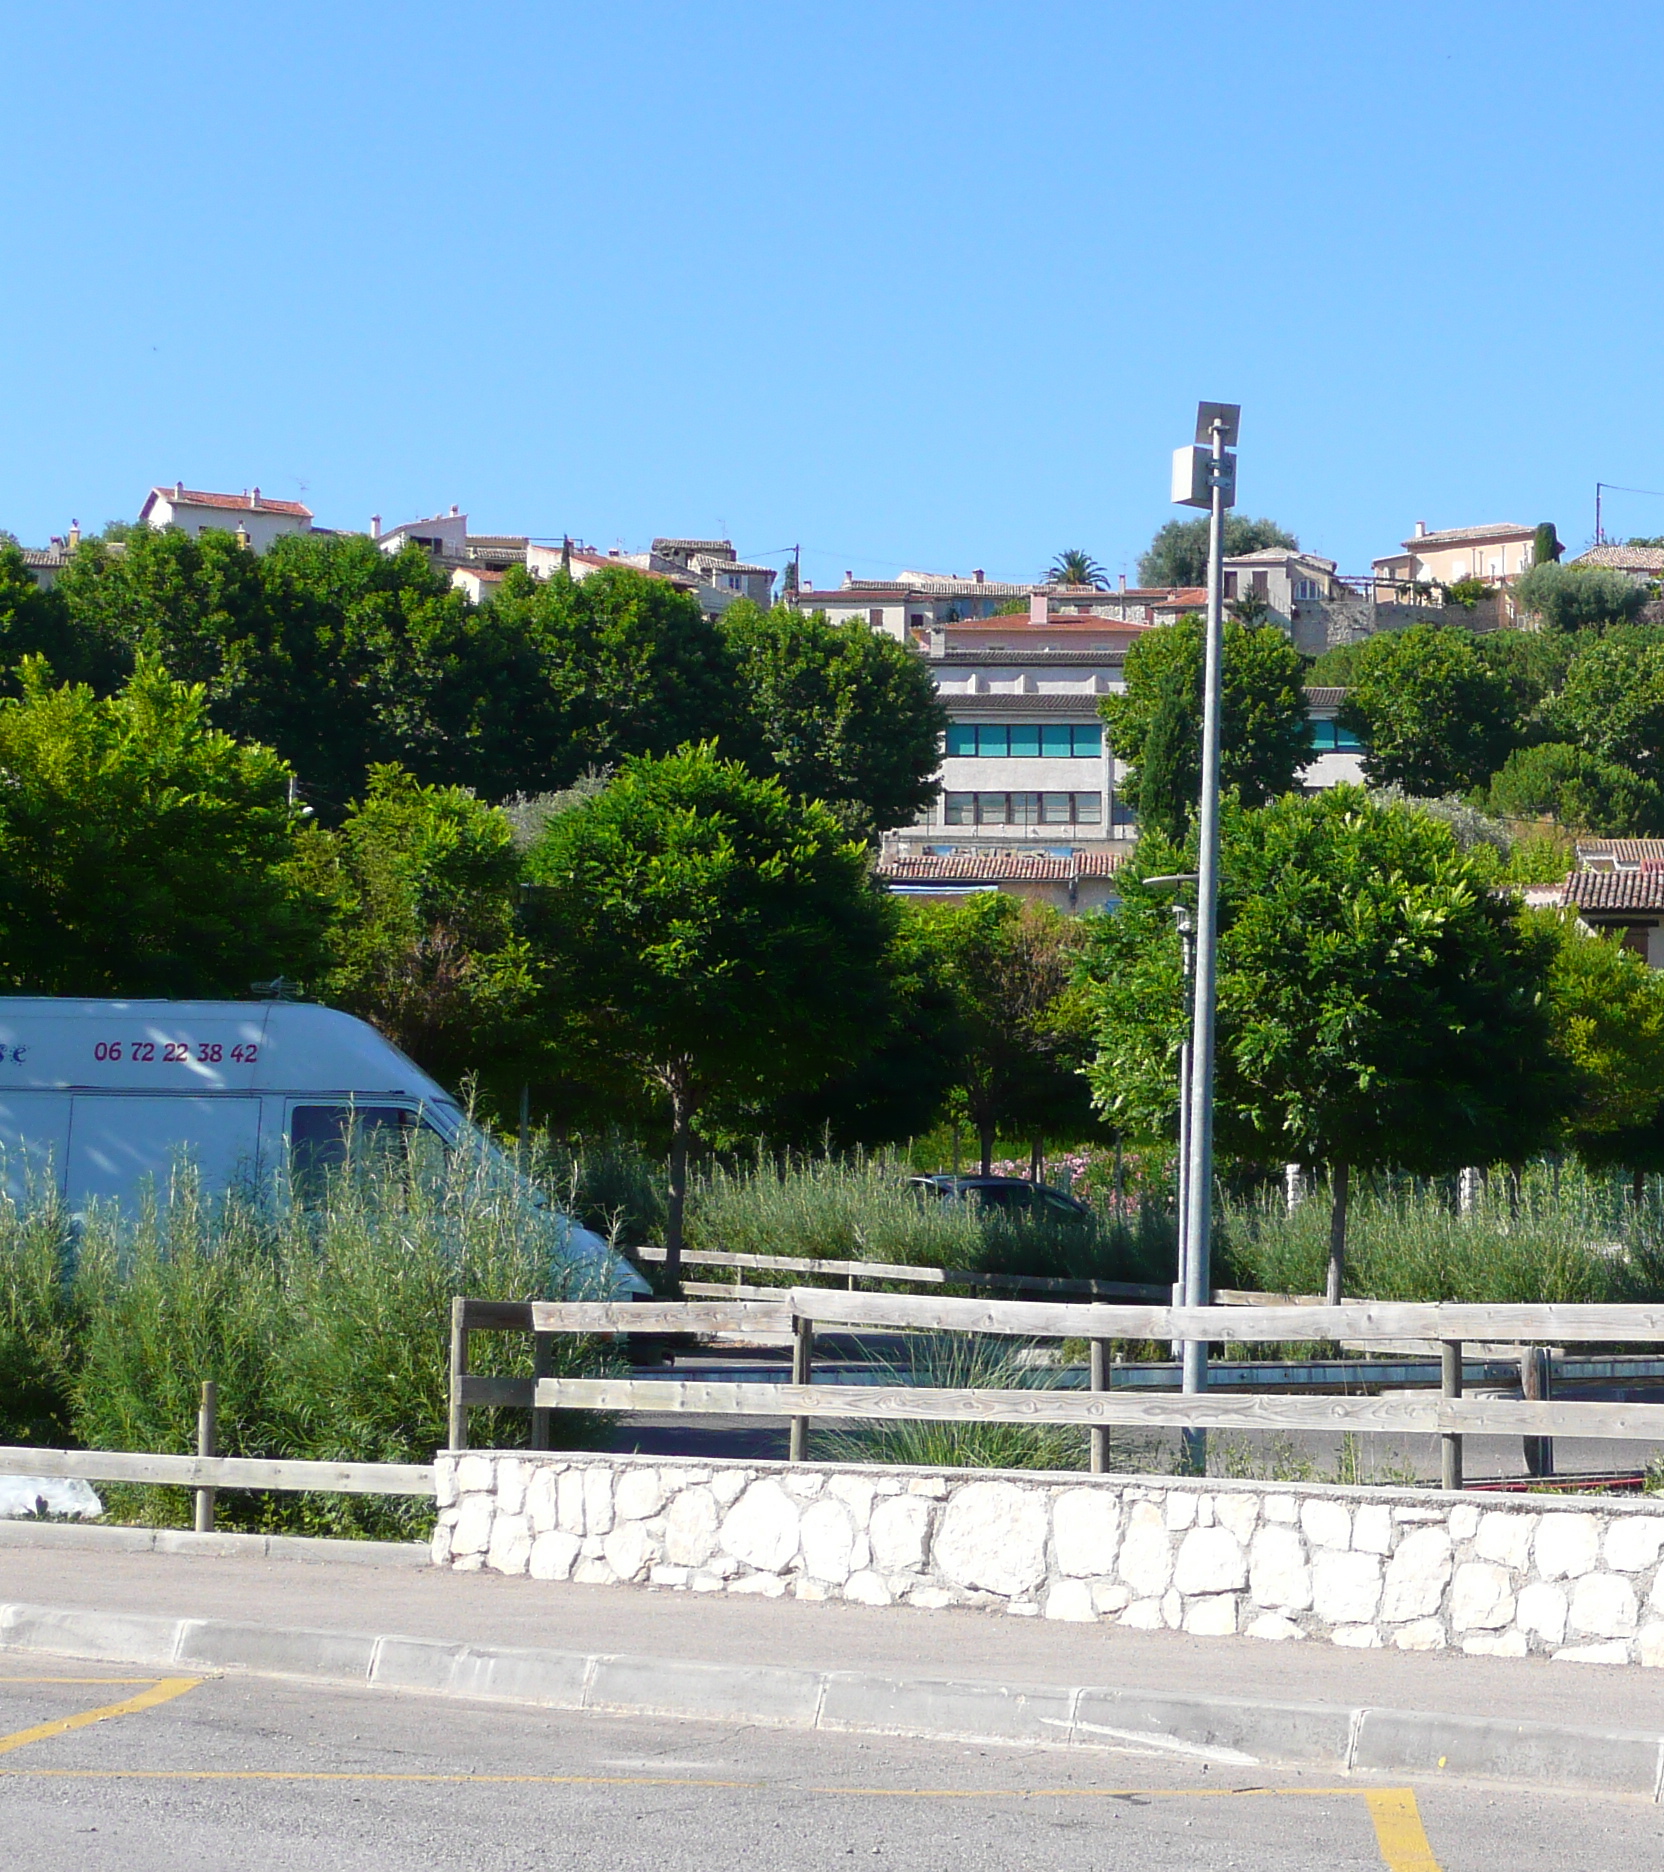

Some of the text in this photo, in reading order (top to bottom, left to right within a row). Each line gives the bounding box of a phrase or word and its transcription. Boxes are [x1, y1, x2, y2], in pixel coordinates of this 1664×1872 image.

[94, 1042, 258, 1063] 06 72 22 38 42
